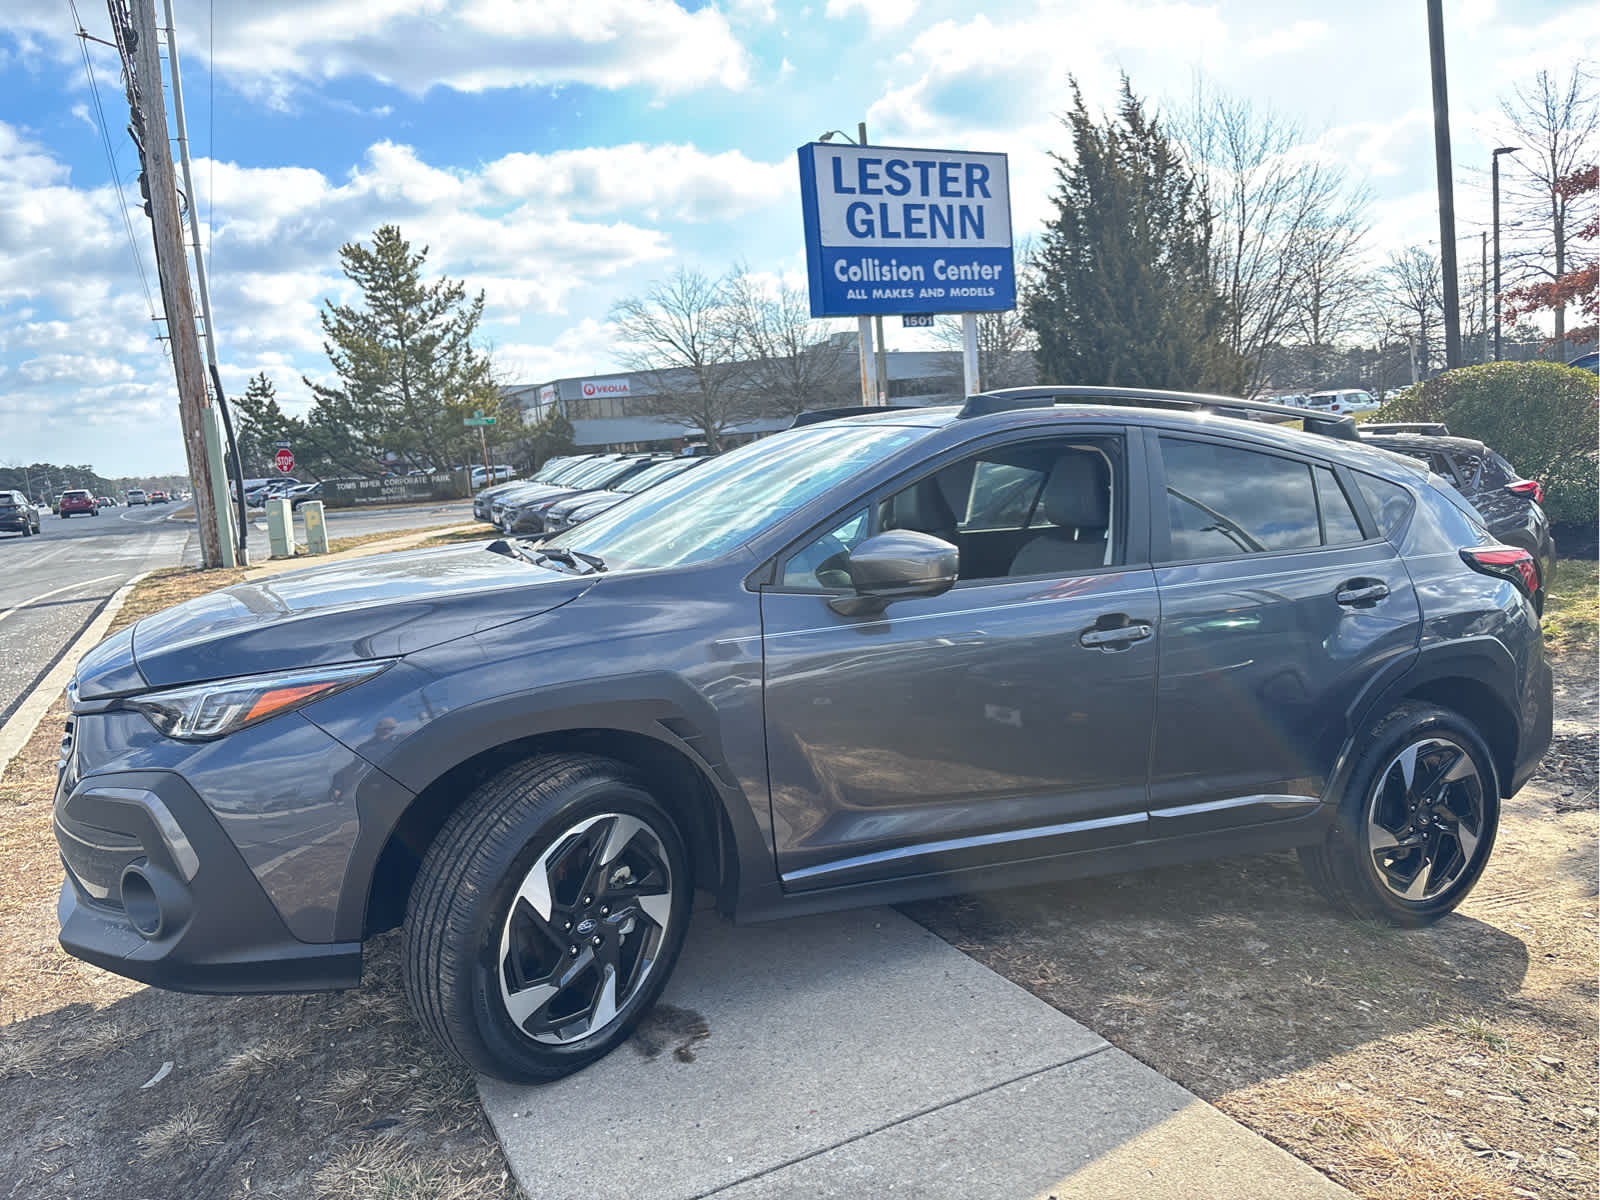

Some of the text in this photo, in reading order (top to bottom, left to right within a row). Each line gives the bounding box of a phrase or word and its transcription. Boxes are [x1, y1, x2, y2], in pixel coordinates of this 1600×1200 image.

[831, 156, 992, 199] LESTER
[846, 201, 985, 240] GLENN
[834, 258, 1003, 282] Collision Center
[847, 287, 995, 300] ALL MAKES AND MODELS
[903, 315, 933, 327] 1501
[597, 385, 628, 393] VEOLIA
[277, 455, 294, 466] STOP
[360, 479, 381, 489] RIVER
[384, 476, 427, 486] CORPORATE
[431, 473, 450, 483] PARK
